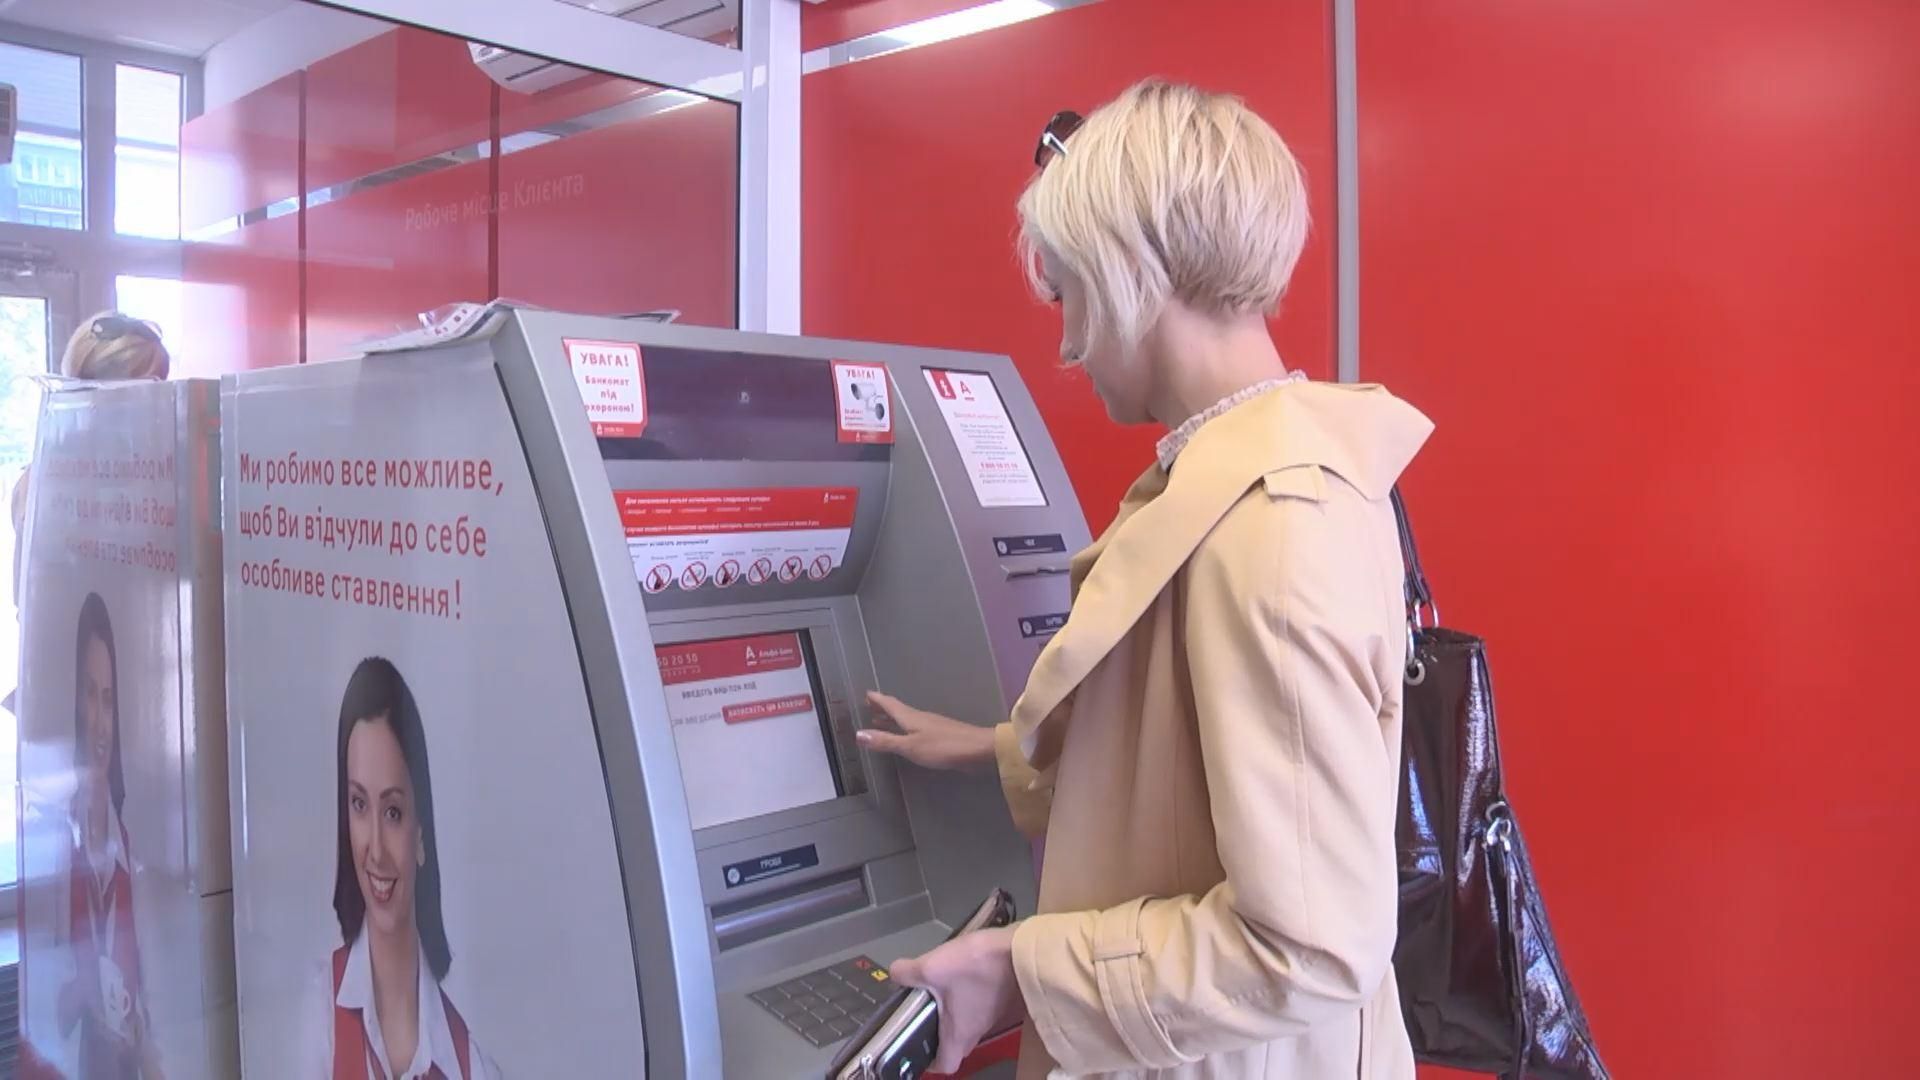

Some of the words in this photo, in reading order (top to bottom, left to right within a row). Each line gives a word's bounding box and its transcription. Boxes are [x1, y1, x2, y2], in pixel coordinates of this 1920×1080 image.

[405, 203, 458, 231] Робоче
[463, 192, 509, 218] місце
[514, 174, 584, 209] Клієнта
[580, 352, 629, 367] УВАГА!
[585, 375, 629, 386] Банкомат
[845, 368, 875, 379] УВАГА!
[600, 389, 617, 400] під
[240, 453, 261, 483] Ми
[266, 452, 334, 491] робимо
[341, 459, 377, 487] все
[385, 459, 504, 497] можливе,
[240, 505, 272, 540] щоб
[278, 506, 299, 538] Ви
[305, 506, 383, 551] відчули
[389, 521, 418, 555] до
[425, 516, 487, 557] себе
[241, 558, 325, 597] особливе
[331, 574, 461, 620] ставлення!
[672, 655, 684, 665] 20
